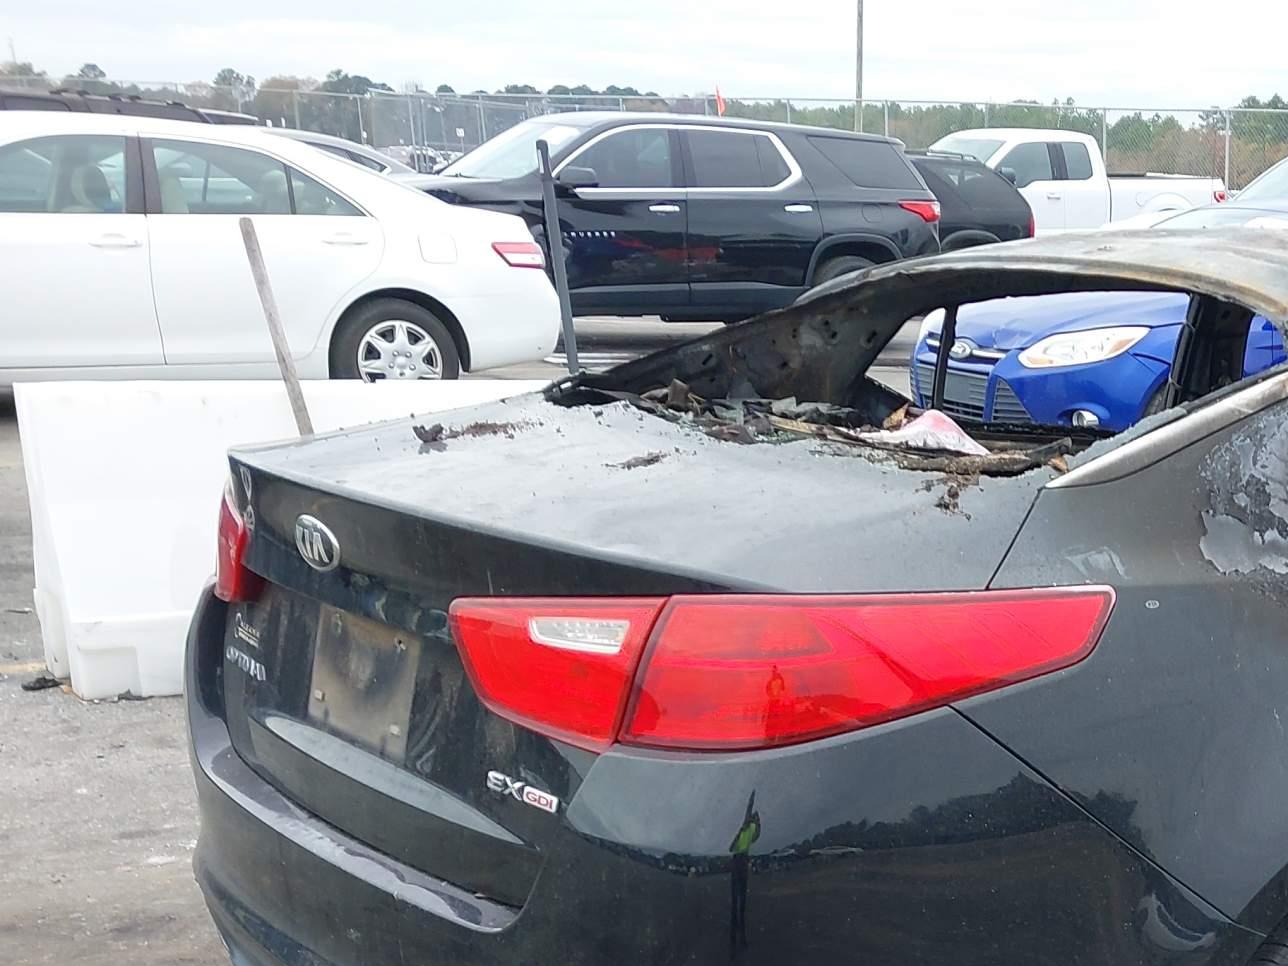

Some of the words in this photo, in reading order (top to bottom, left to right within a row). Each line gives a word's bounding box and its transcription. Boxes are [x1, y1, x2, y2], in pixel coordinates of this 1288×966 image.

[296, 523, 330, 564] KIA
[487, 770, 525, 801] EX
[525, 790, 555, 811] GDI
